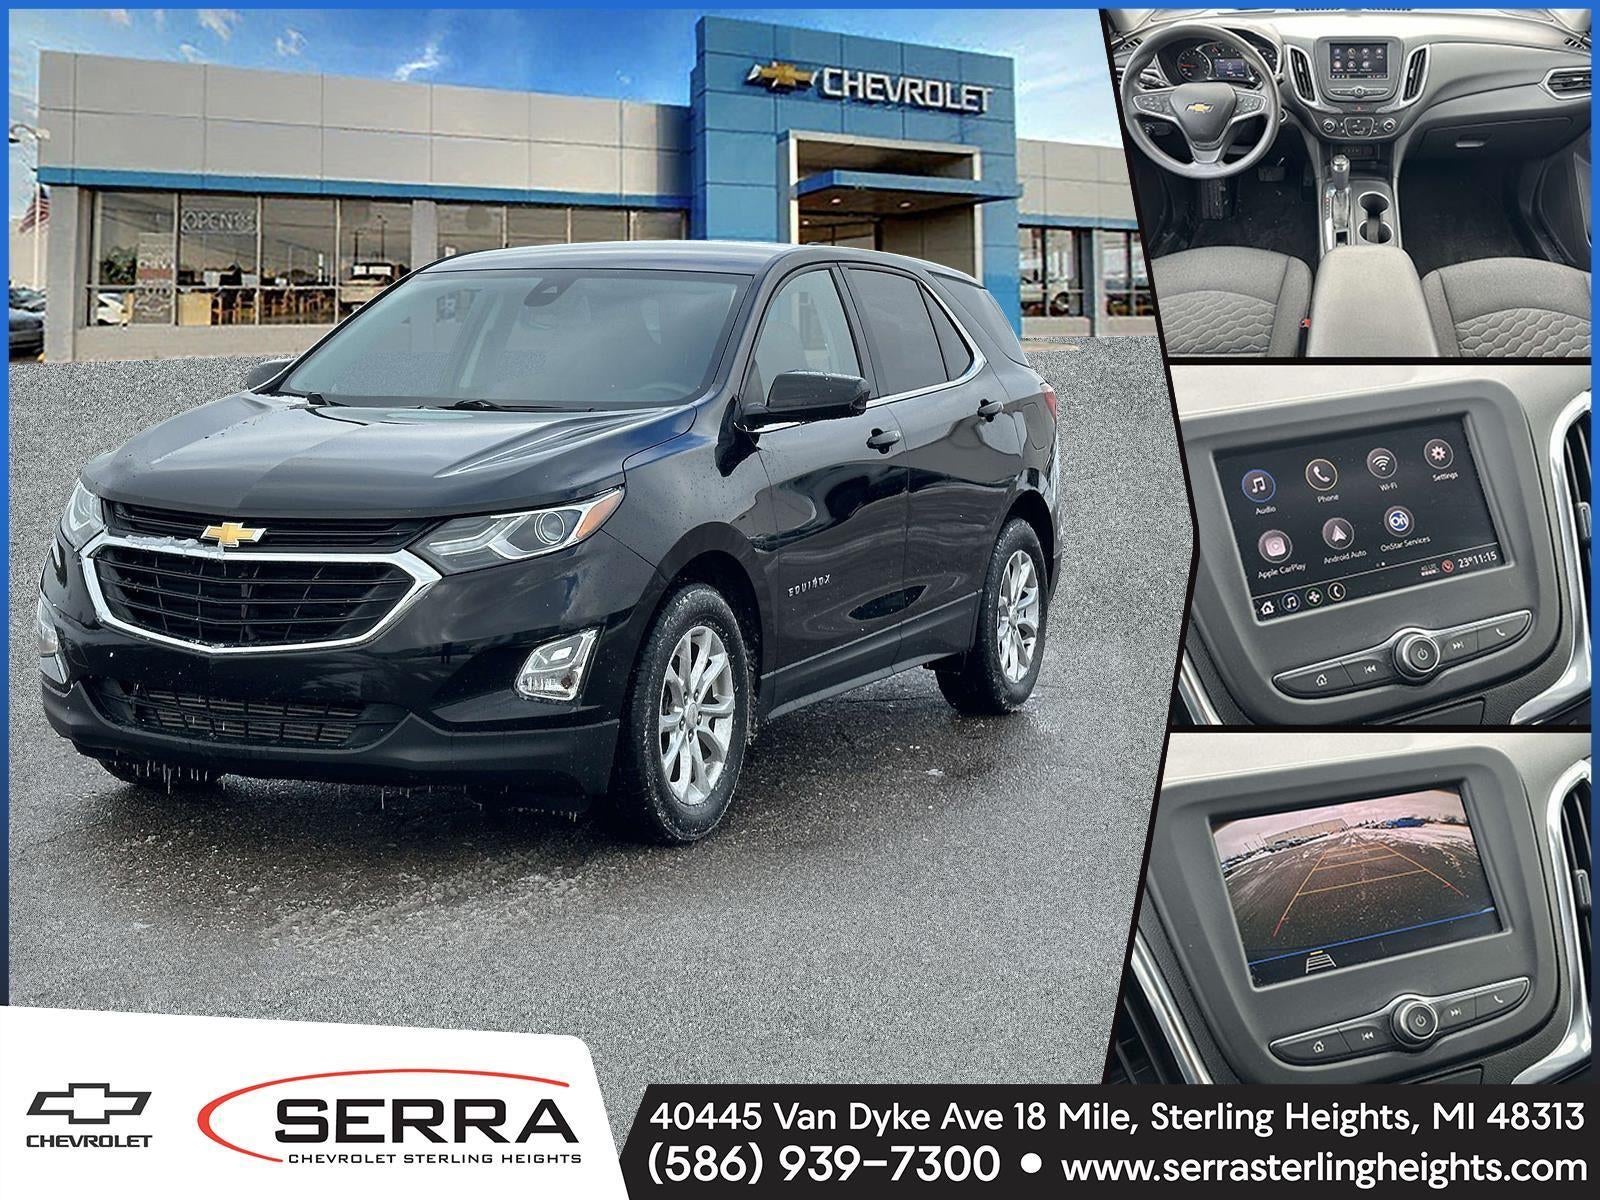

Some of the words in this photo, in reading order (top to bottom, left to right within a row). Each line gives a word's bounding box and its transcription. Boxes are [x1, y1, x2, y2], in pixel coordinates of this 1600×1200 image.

[823, 67, 993, 112] CHEVROLET
[1432, 470, 1459, 483] Settings
[1379, 481, 1398, 492] Wi-Fi
[1317, 493, 1340, 503] Phone
[1255, 505, 1277, 515] Audio
[1380, 541, 1404, 552] OnStar
[1403, 536, 1431, 548] Services
[1323, 553, 1350, 565] Android
[1350, 550, 1367, 559] Auto
[1258, 567, 1279, 579] Apple
[1279, 563, 1307, 574] CarPlay
[788, 573, 831, 598] EQUINOX
